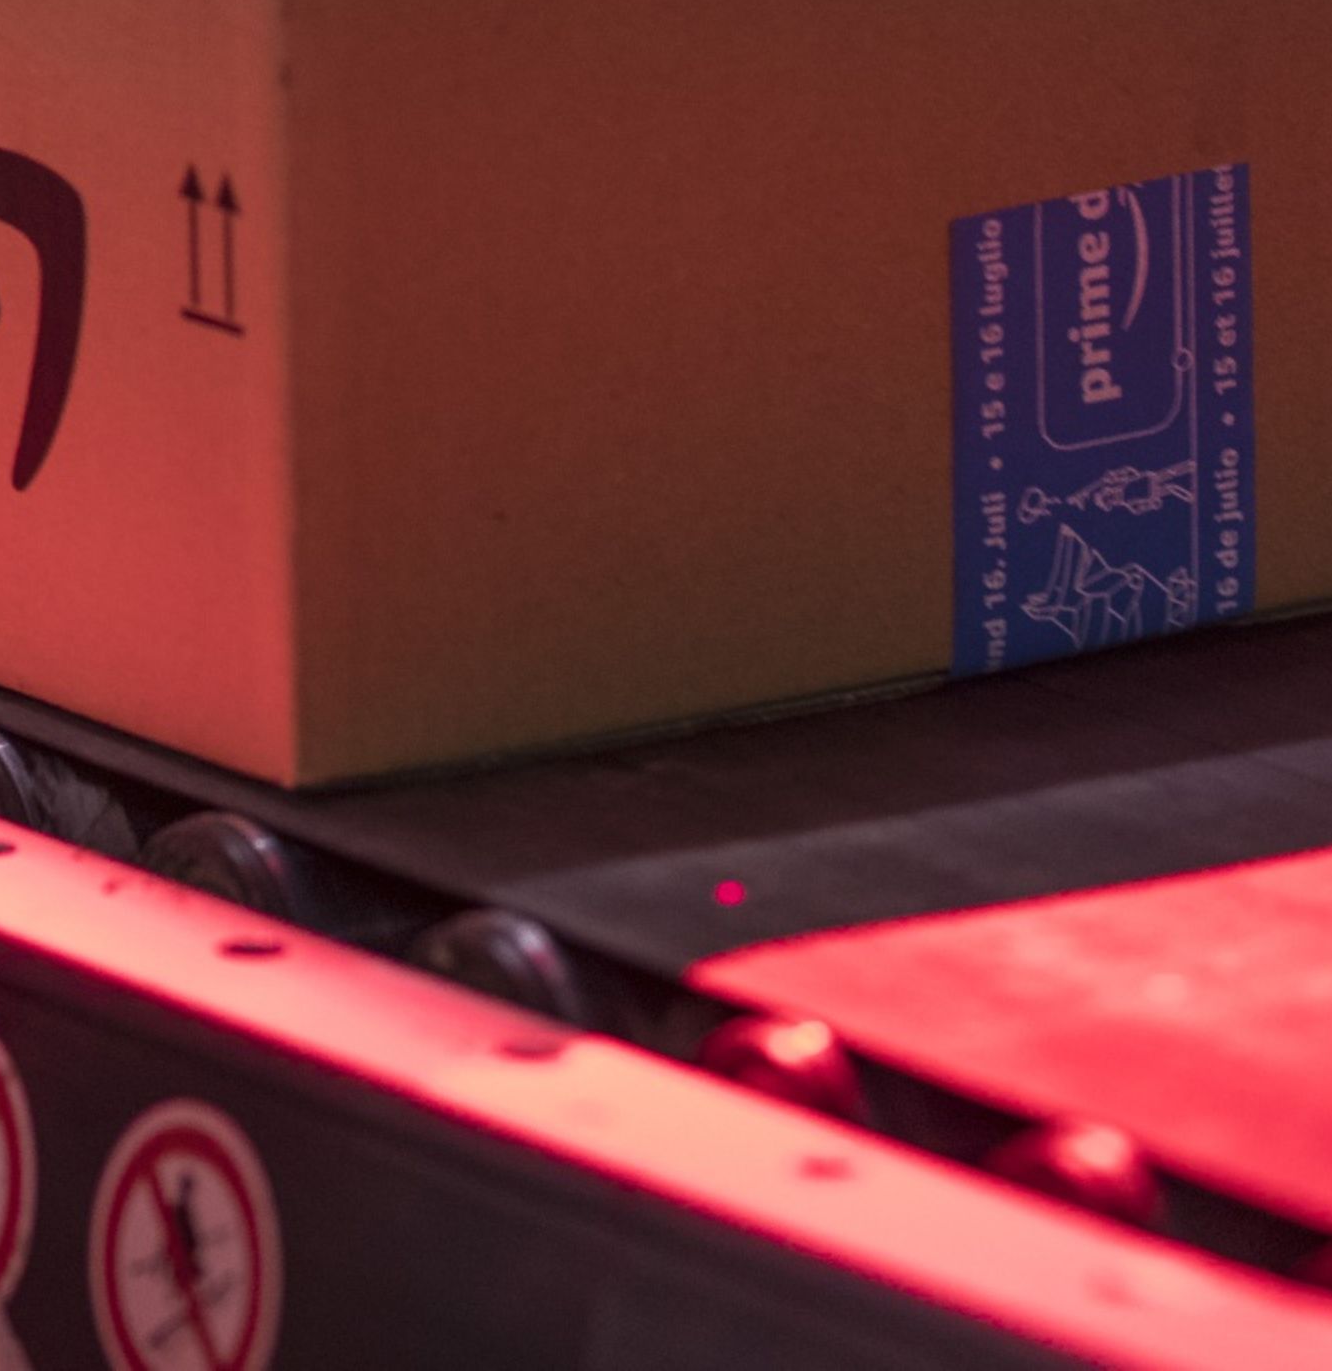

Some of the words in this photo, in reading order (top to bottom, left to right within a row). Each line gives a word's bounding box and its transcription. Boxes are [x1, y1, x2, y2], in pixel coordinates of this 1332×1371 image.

[975, 217, 1010, 318] luglio
[1211, 266, 1237, 307] 16
[1067, 231, 1124, 405] prime
[1214, 313, 1238, 347] et
[979, 323, 1005, 366] 16
[985, 372, 1006, 392] e
[1213, 355, 1238, 396] 15
[980, 399, 1007, 441] 15
[1213, 446, 1245, 521] julio
[980, 491, 1007, 551] Juli
[1214, 529, 1240, 569] de
[1216, 575, 1240, 616] 16
